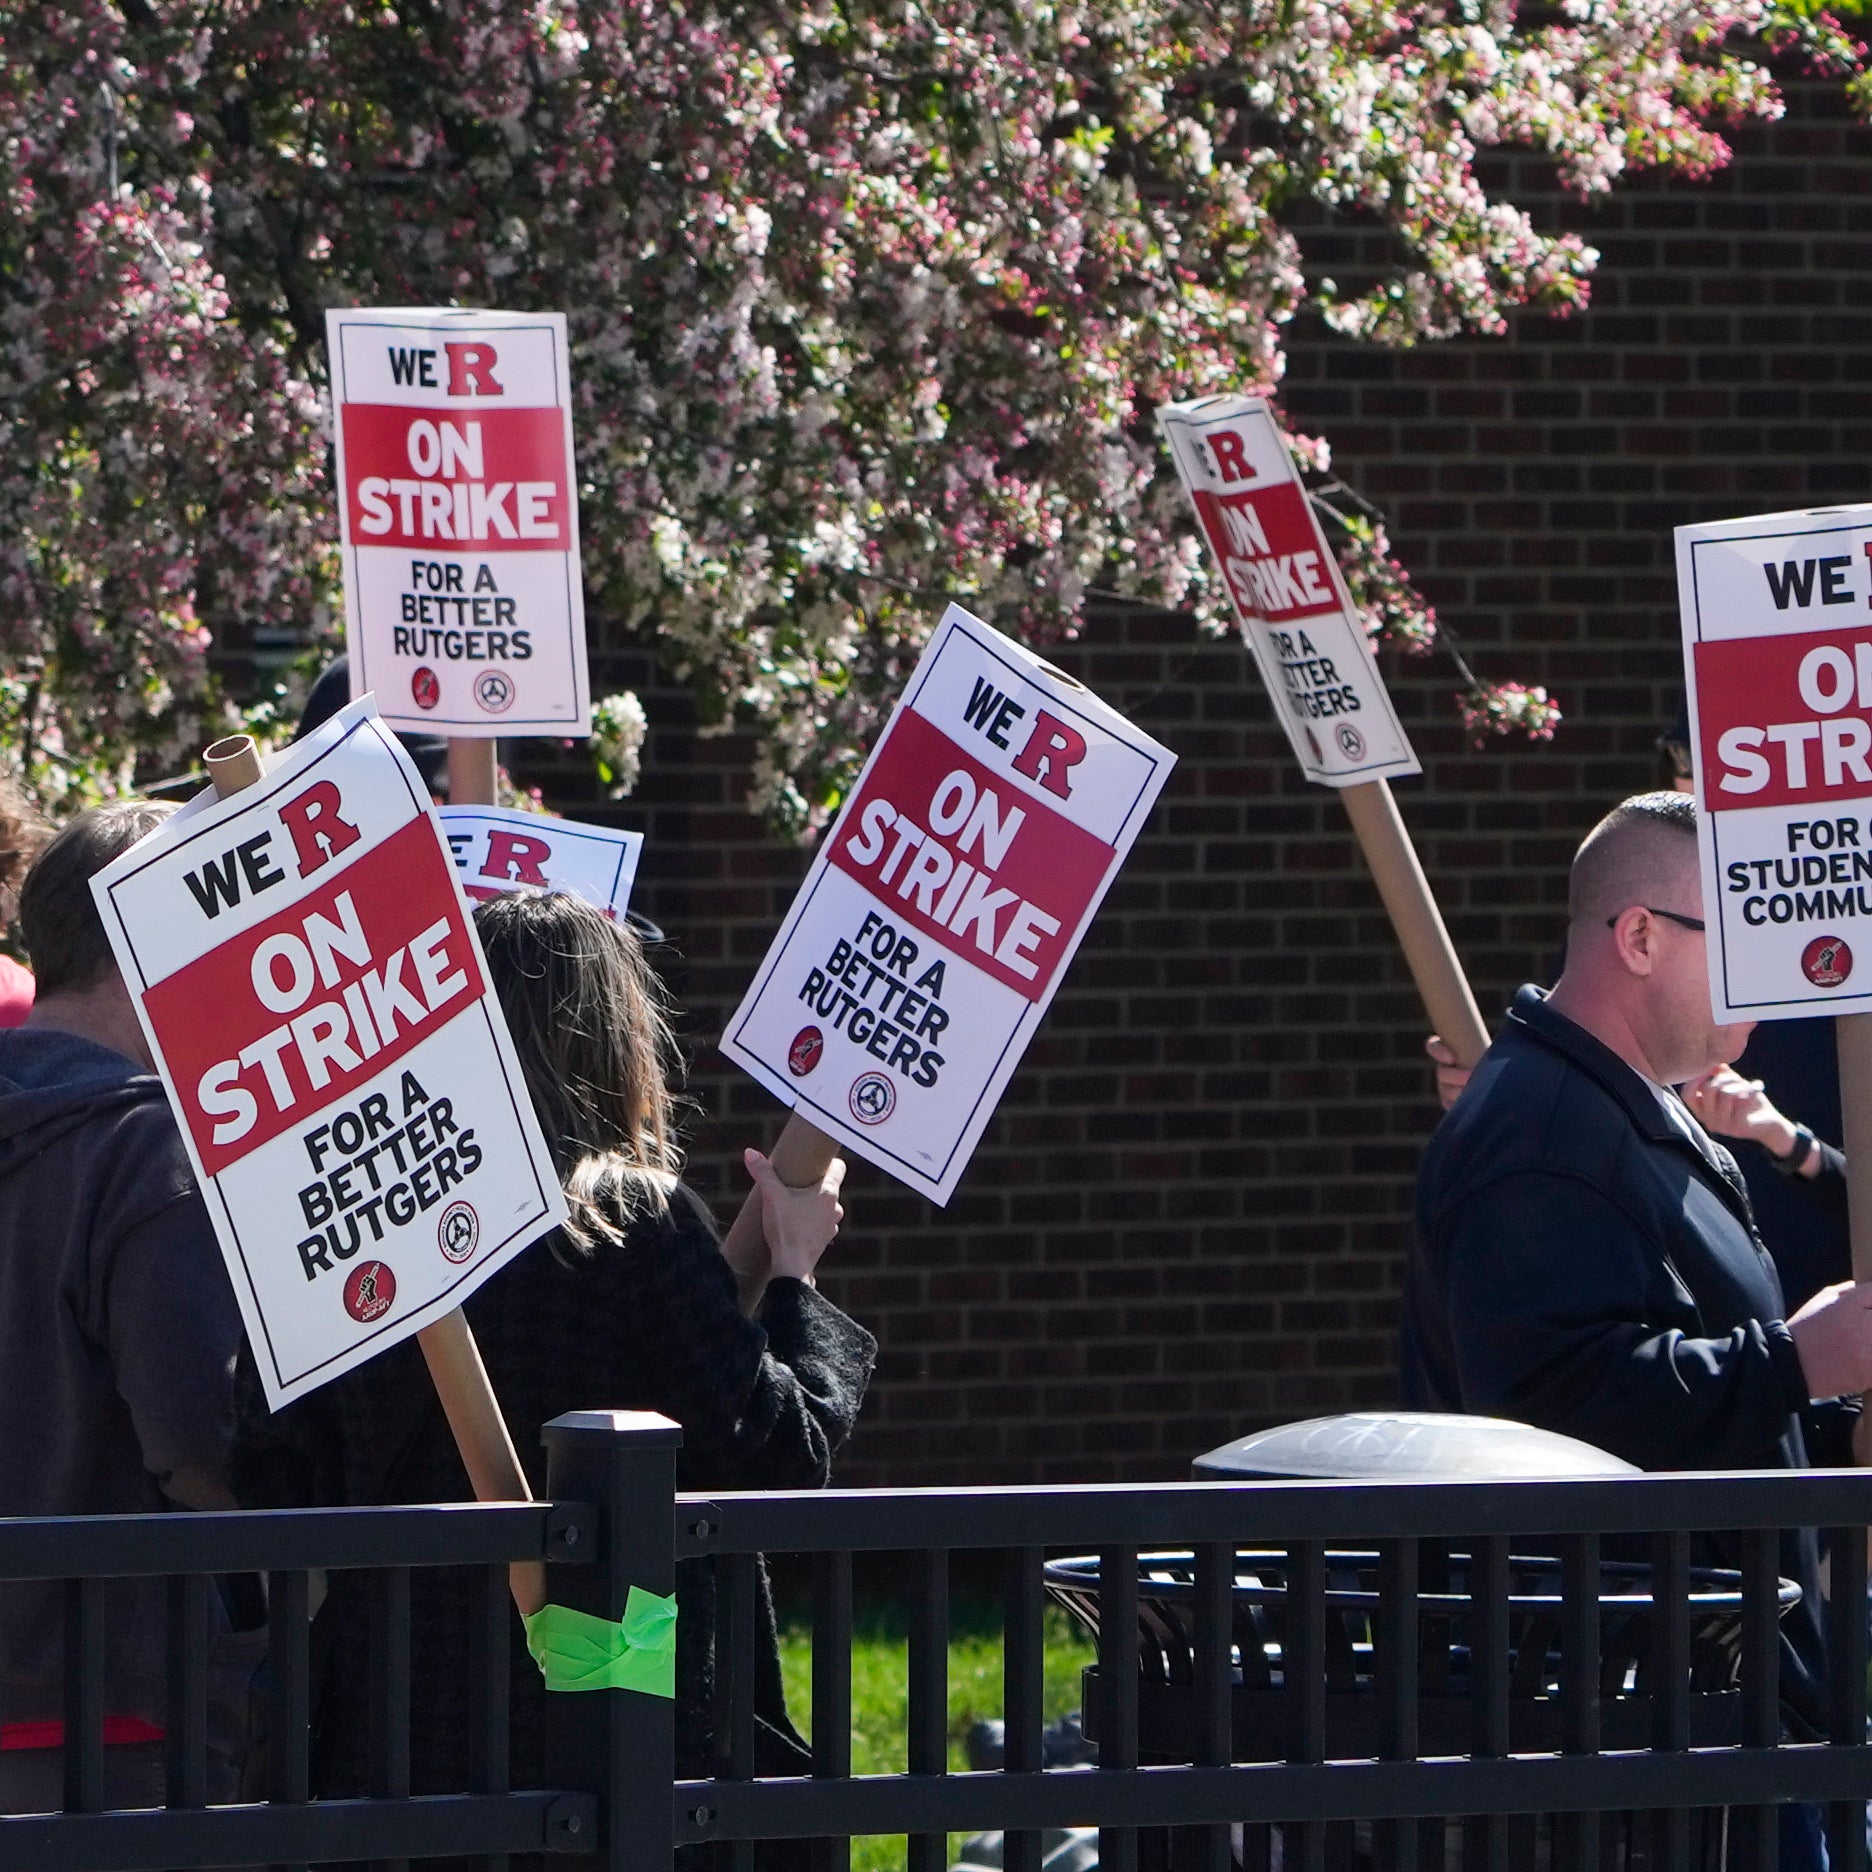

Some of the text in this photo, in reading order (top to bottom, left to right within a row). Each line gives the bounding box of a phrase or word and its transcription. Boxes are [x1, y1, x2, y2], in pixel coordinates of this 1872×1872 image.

[388, 342, 504, 396] WE R
[407, 418, 484, 479] ON
[1206, 430, 1258, 484] R
[357, 477, 560, 540] STRIKE
[401, 593, 517, 626] BETTER
[411, 560, 498, 593] FOR A
[1763, 555, 1855, 610] WE
[393, 626, 533, 660] RUTGERS
[1298, 629, 1318, 655] A
[962, 675, 1089, 801] WE R
[1717, 719, 1872, 795] STR
[182, 778, 362, 920] WE R
[479, 829, 552, 888] R
[929, 769, 1026, 872] ON
[1787, 817, 1861, 853] FOR
[845, 798, 1062, 982] STRIKE
[1727, 850, 1872, 893] STUDEN
[250, 889, 372, 1016] ON
[825, 937, 950, 1039] BETTER
[854, 909, 946, 1001] FOR A
[197, 915, 468, 1146] STRIKE
[798, 967, 946, 1089] RUTGERS
[305, 1069, 430, 1175] FOR A
[297, 1095, 460, 1230] BETTER
[296, 1136, 483, 1282] RUTGERS
